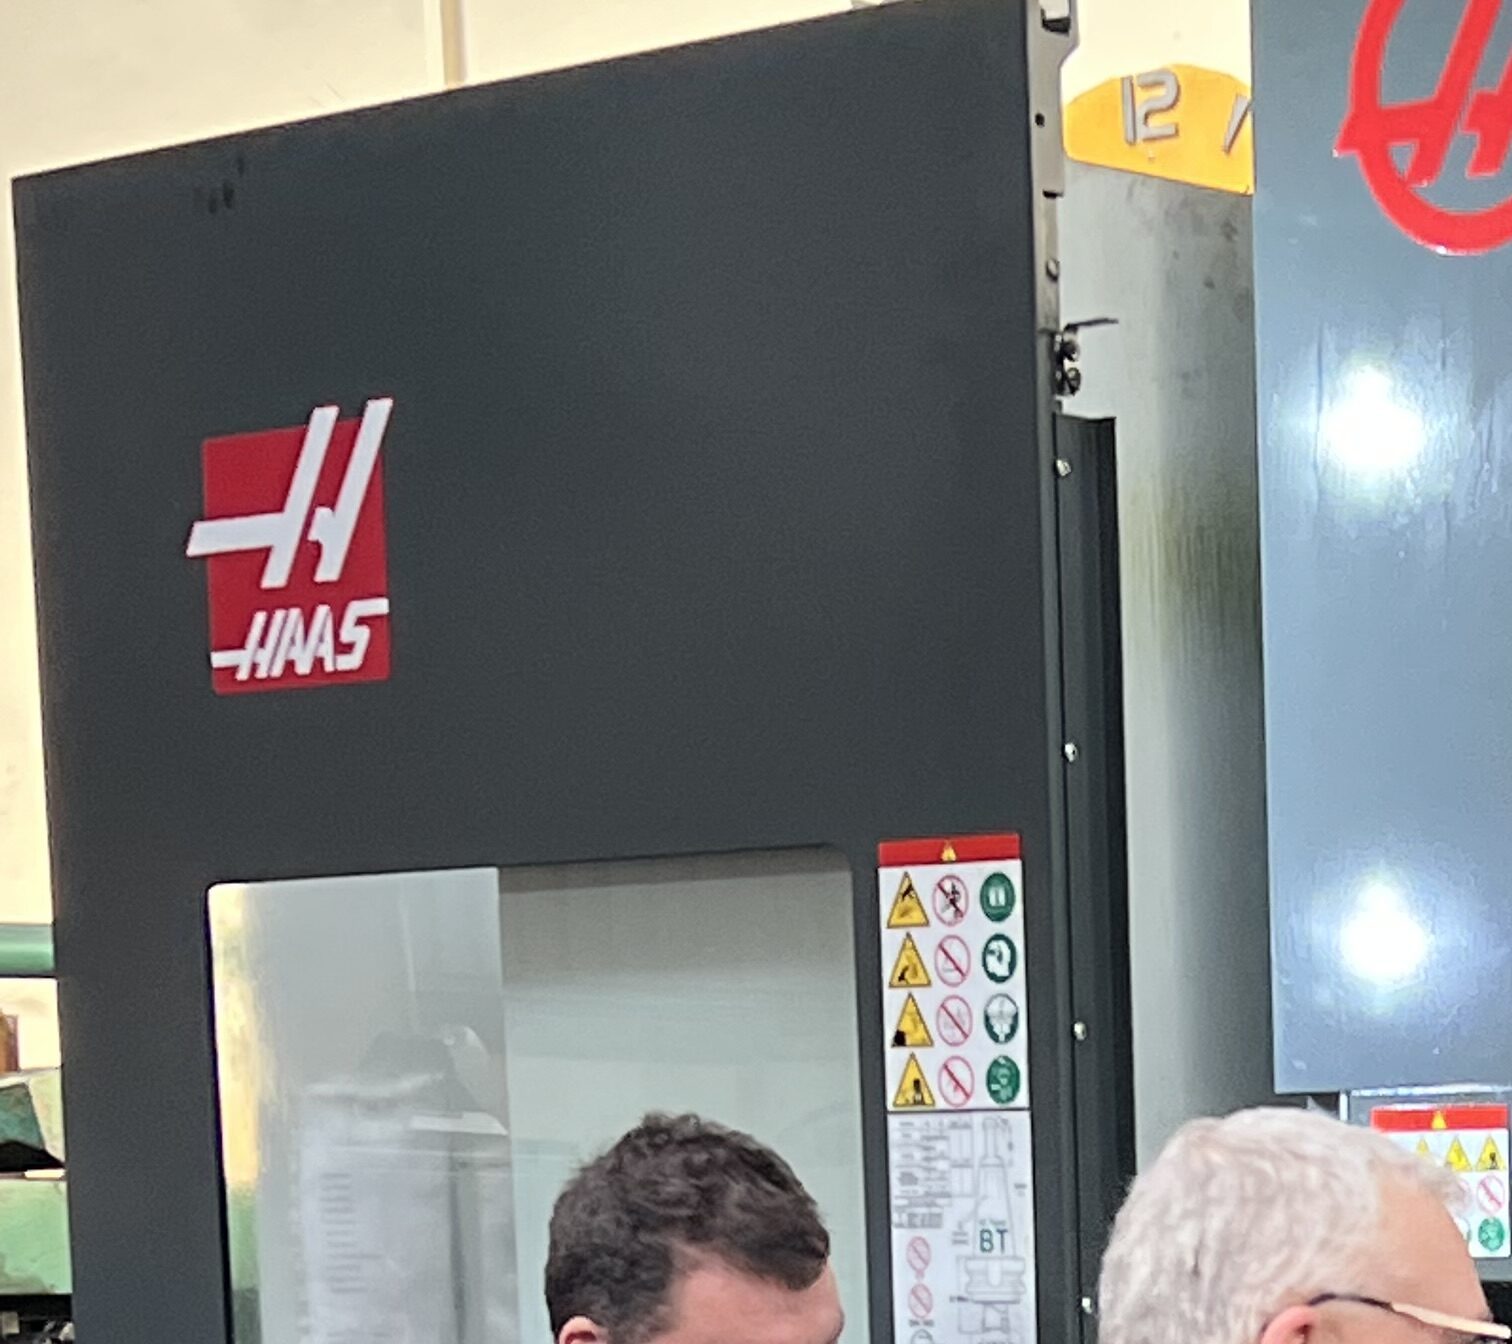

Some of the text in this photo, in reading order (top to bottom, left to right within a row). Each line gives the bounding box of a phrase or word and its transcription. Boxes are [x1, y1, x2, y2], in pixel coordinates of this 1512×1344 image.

[1121, 68, 1180, 145] 12
[210, 597, 390, 682] HAAS
[979, 1228, 1008, 1254] BT
